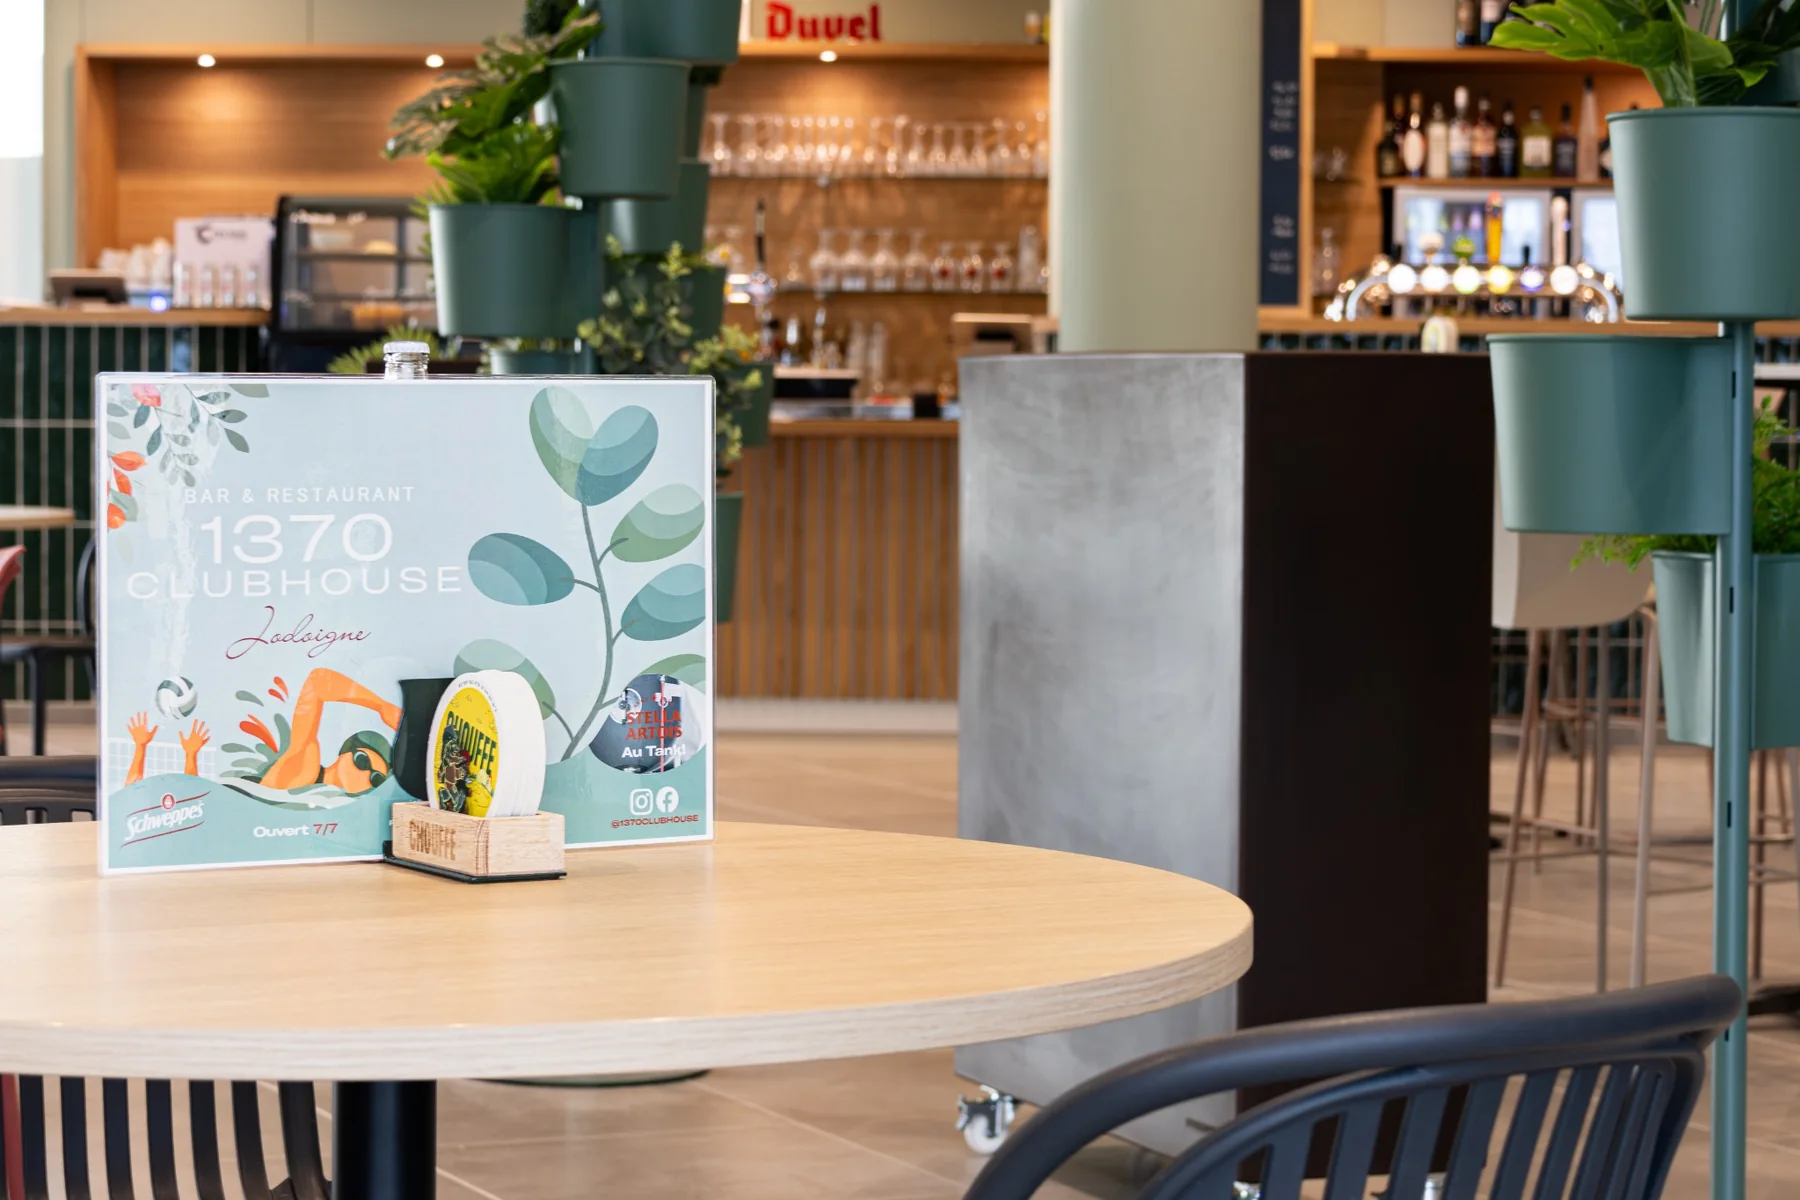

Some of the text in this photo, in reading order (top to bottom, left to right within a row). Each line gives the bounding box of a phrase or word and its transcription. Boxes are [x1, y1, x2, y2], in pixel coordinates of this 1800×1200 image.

[767, 2, 881, 41] Duvel
[185, 486, 414, 504] BAR & RESTAURANT
[200, 513, 392, 564] 1370
[126, 566, 462, 599] CLUBHOUSE
[626, 710, 682, 725] STELLA
[625, 725, 682, 740] ARTOIS
[621, 744, 686, 758] Au Tank!
[124, 801, 205, 841] Schweppes
[611, 815, 699, 828] @1370CLUBHOUSE
[253, 823, 338, 838] Ouvert 7/7
[409, 819, 456, 860] CHOUFFE
